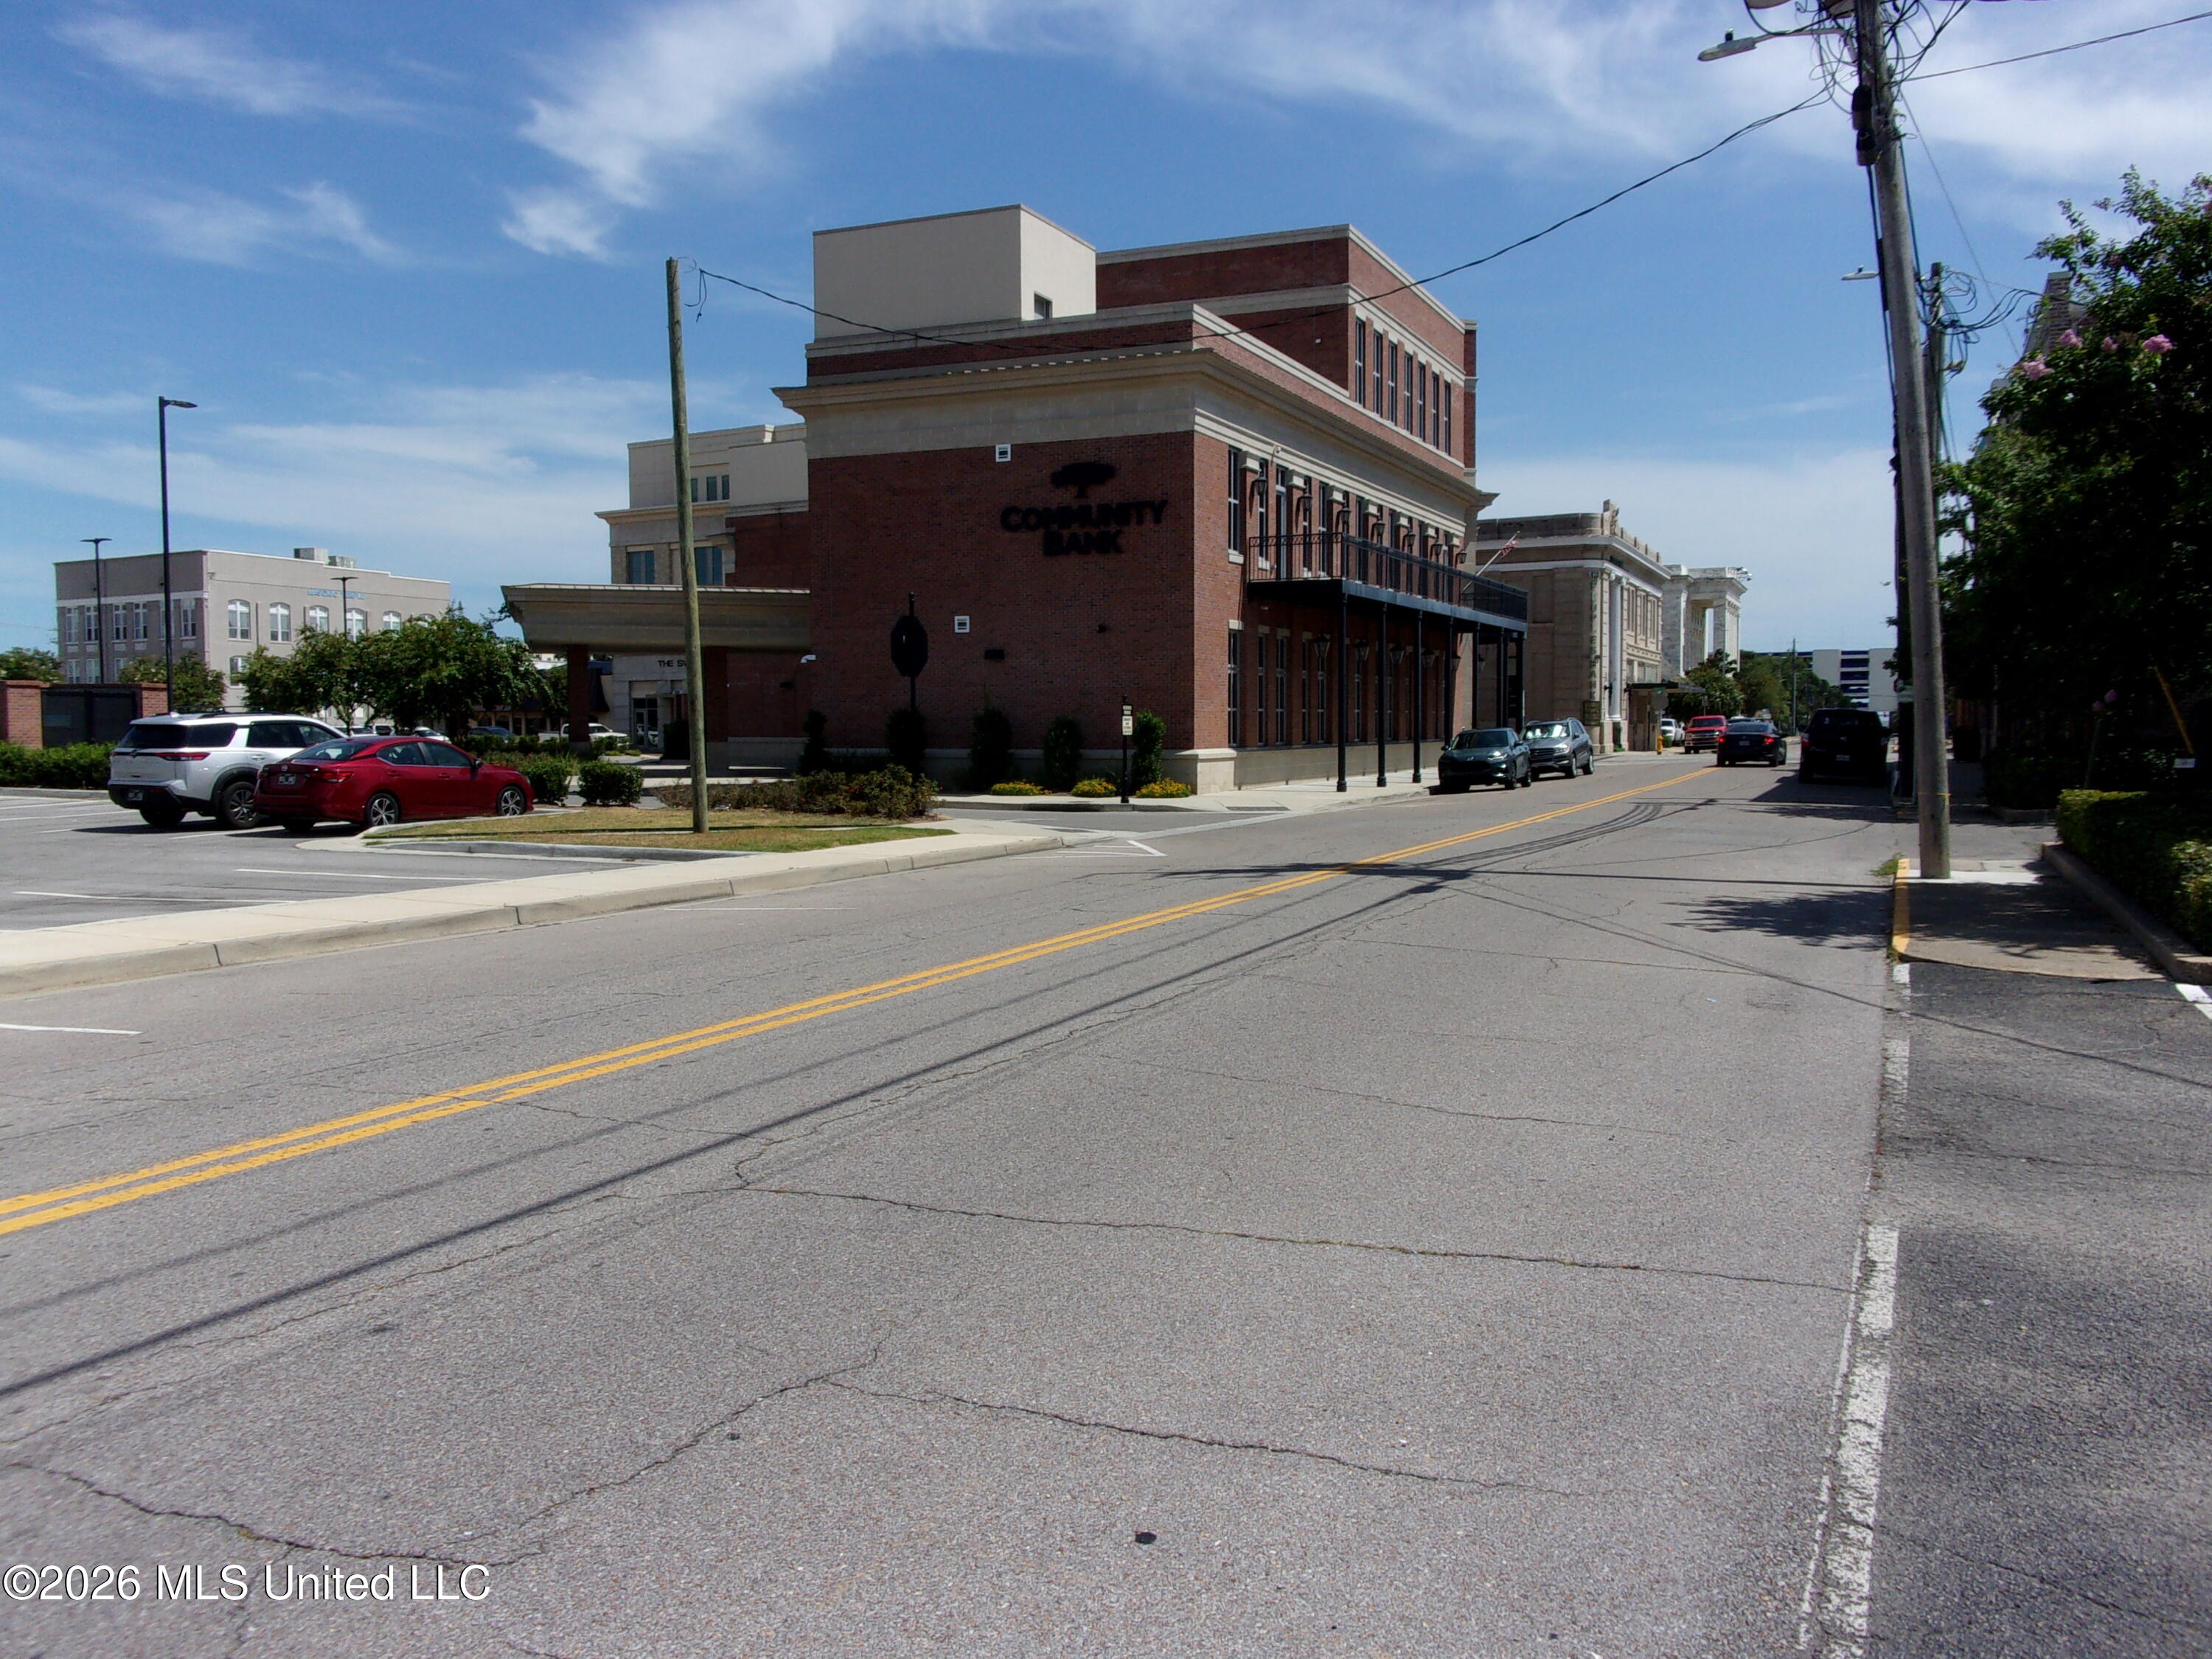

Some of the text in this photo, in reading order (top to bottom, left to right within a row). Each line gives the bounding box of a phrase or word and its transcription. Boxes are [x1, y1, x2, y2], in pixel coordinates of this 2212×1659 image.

[1000, 499, 1168, 532] COMMUNITY
[1043, 529, 1124, 557] BANK
[657, 660, 674, 668] THE
